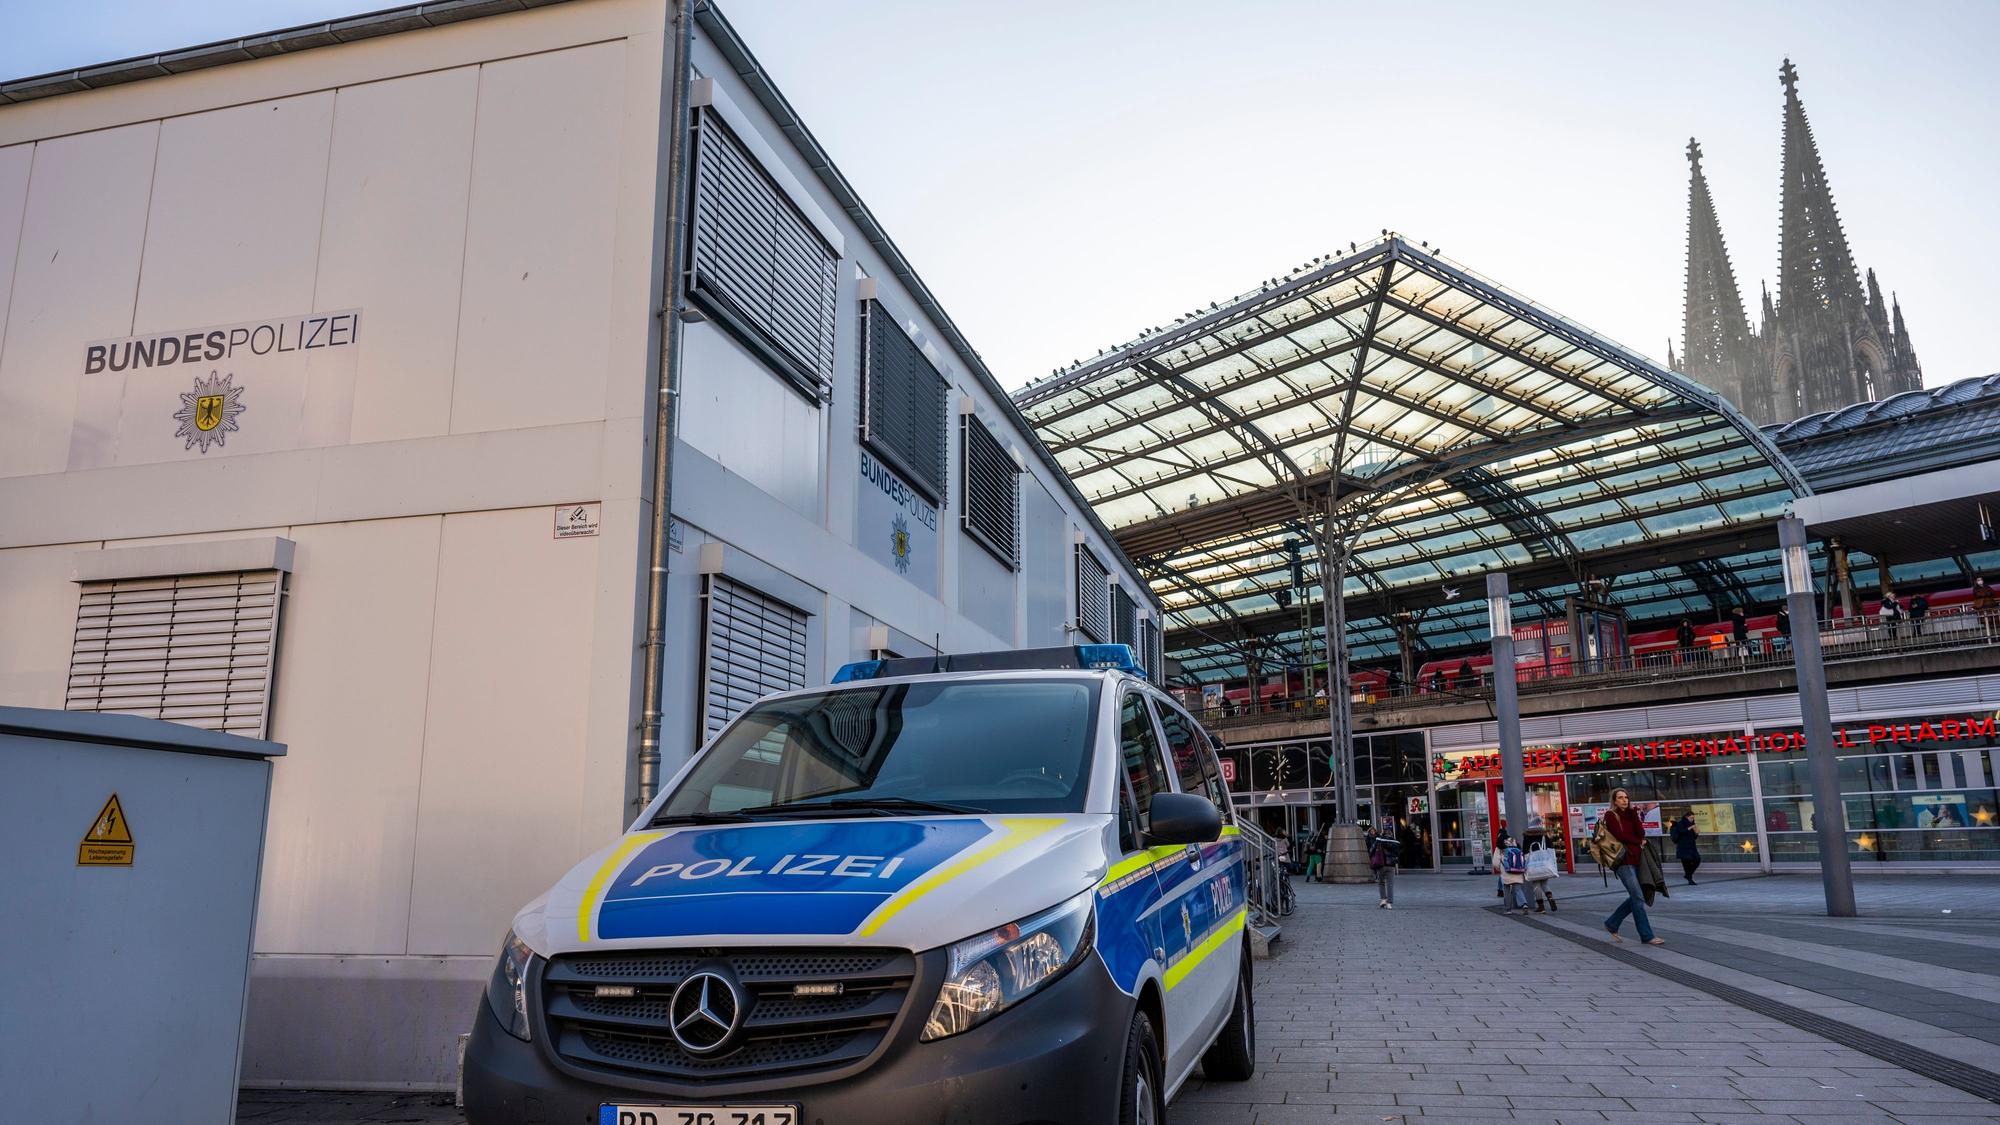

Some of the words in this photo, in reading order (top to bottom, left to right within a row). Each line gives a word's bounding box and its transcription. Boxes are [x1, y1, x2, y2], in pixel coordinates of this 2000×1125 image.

[85, 313, 358, 374] BUNDESPOLIZEI
[861, 452, 937, 533] BUNDESPOLIZEI
[1459, 748, 1579, 772] APOHEKE
[1619, 727, 1856, 762] INTERNATIONL
[1869, 716, 1996, 745] PHARM
[630, 854, 904, 887] POLIZEI
[1211, 876, 1233, 919] POLIZEI
